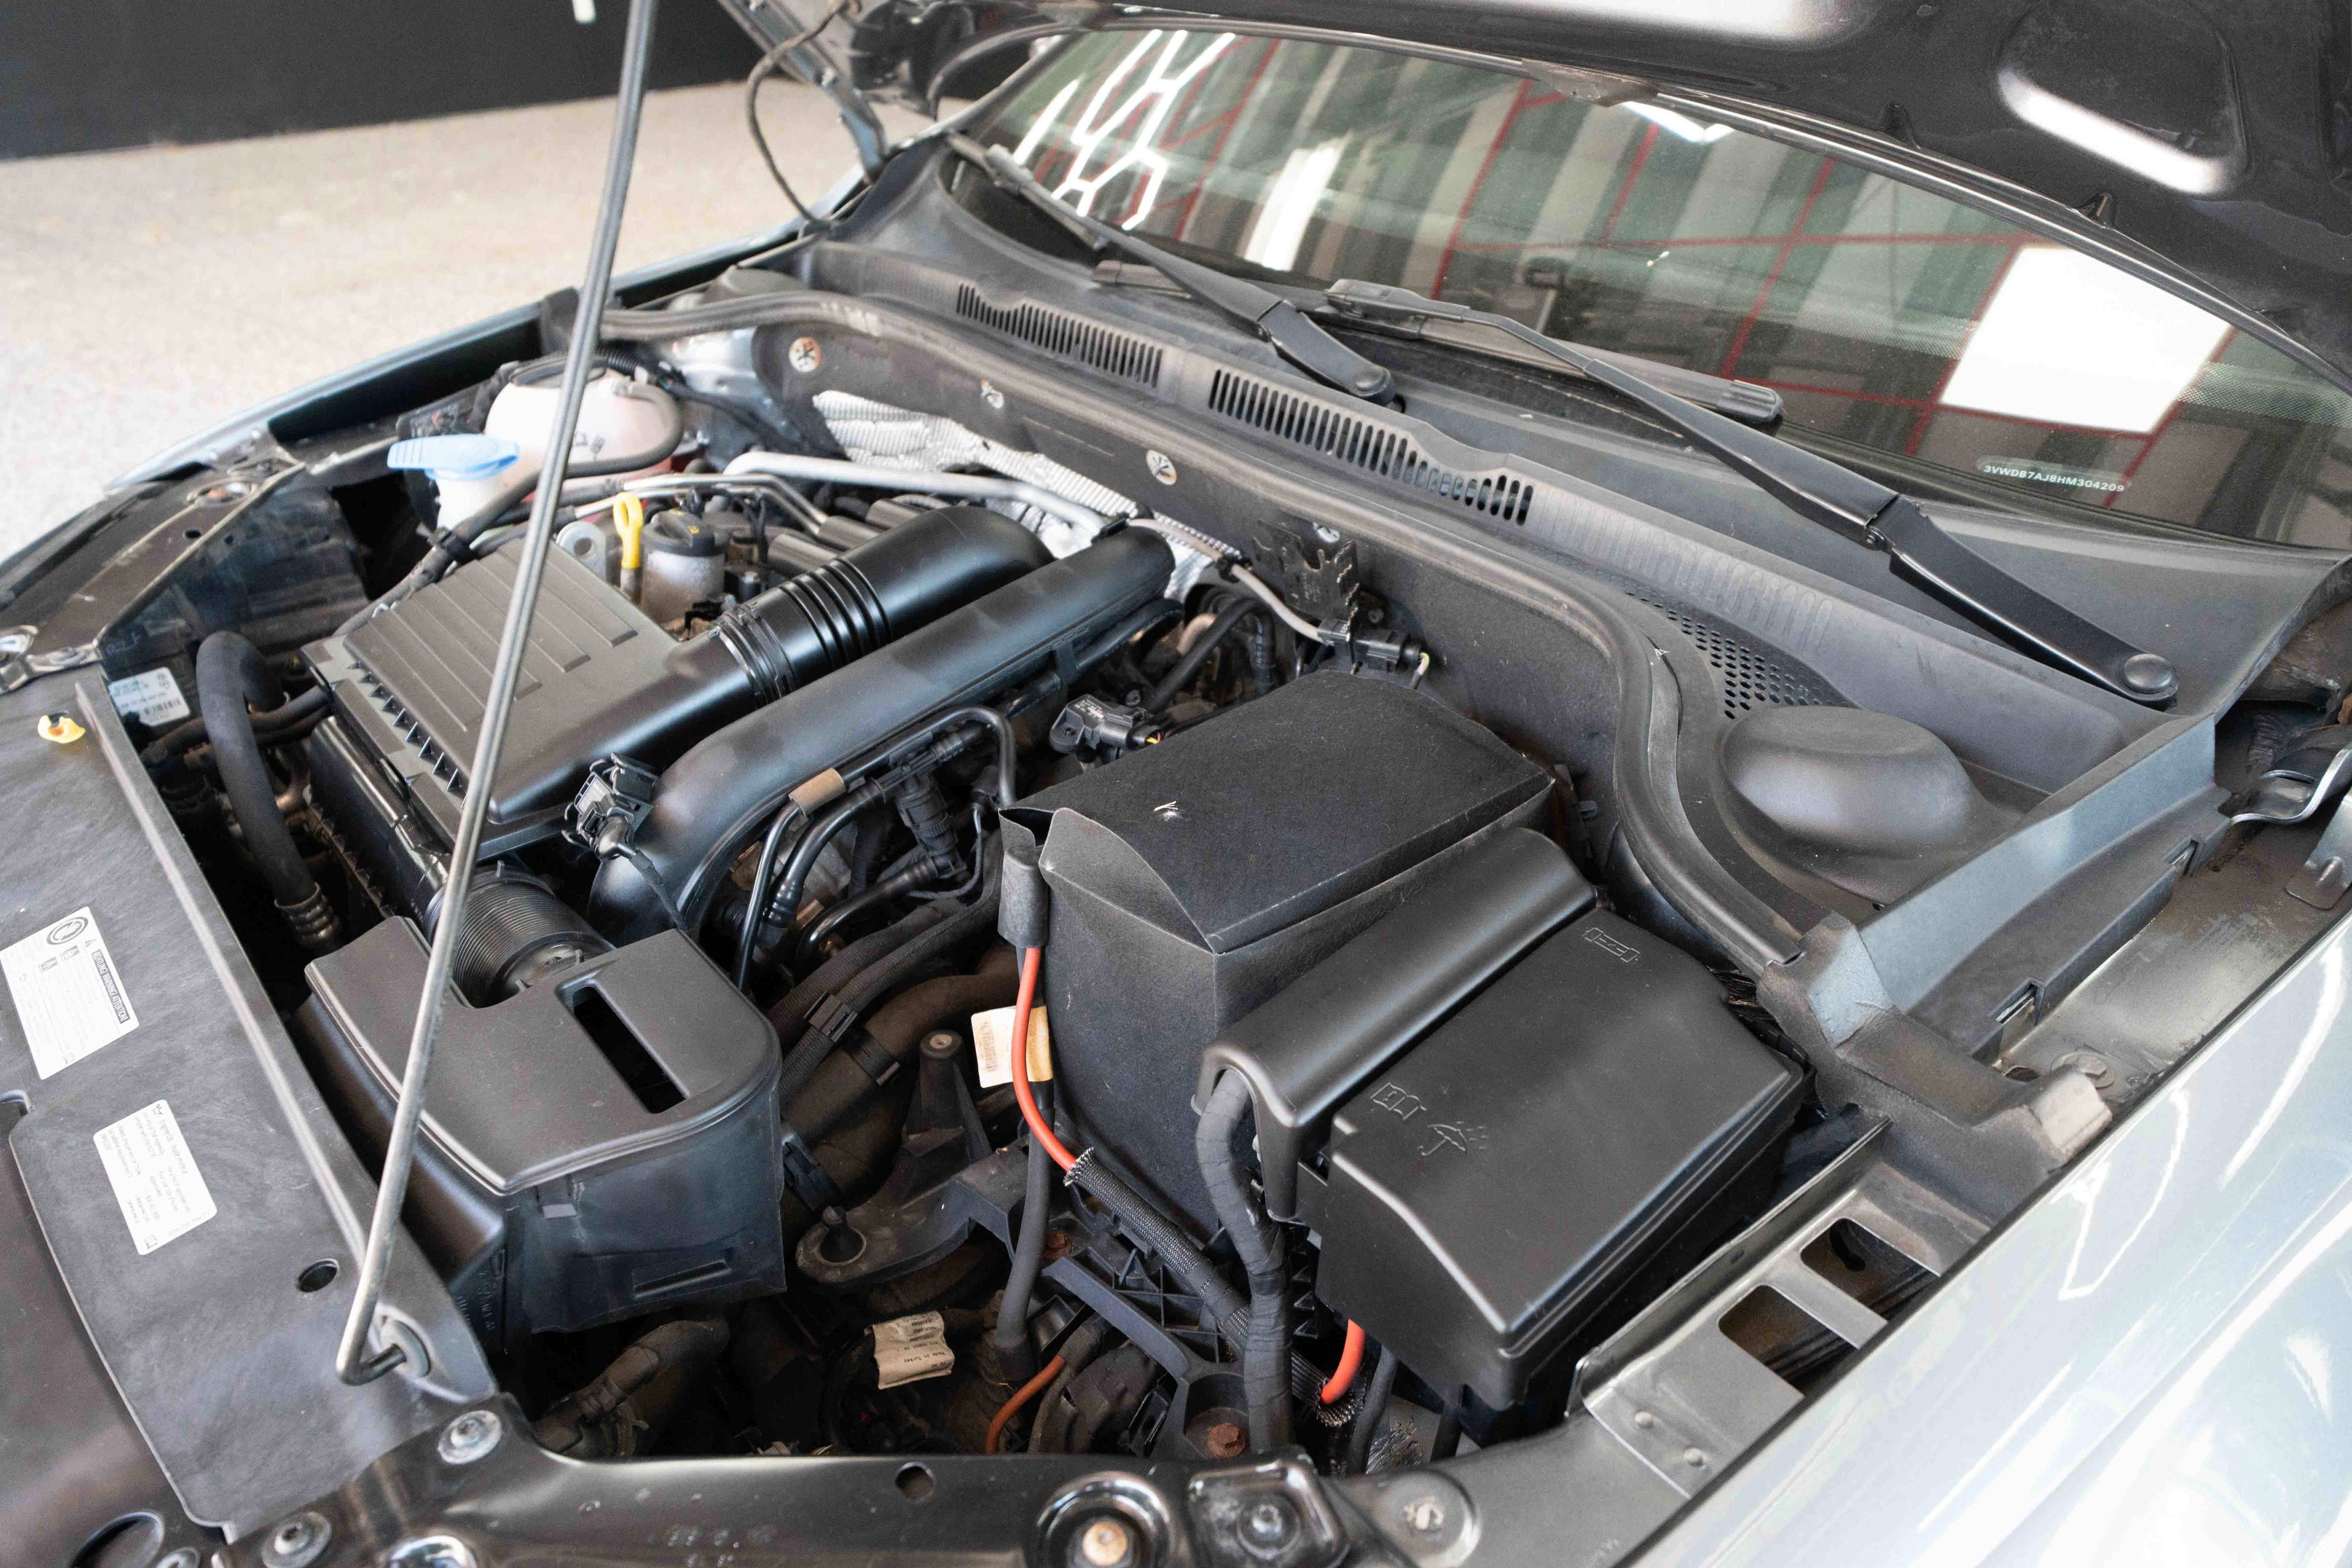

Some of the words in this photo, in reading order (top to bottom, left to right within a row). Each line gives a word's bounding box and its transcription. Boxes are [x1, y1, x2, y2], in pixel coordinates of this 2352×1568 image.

[1984, 465, 2124, 492] 3VWDB7AJ8HM304209
[102, 972, 119, 997] WARNING!
[111, 994, 129, 1022] ATTENTION!
